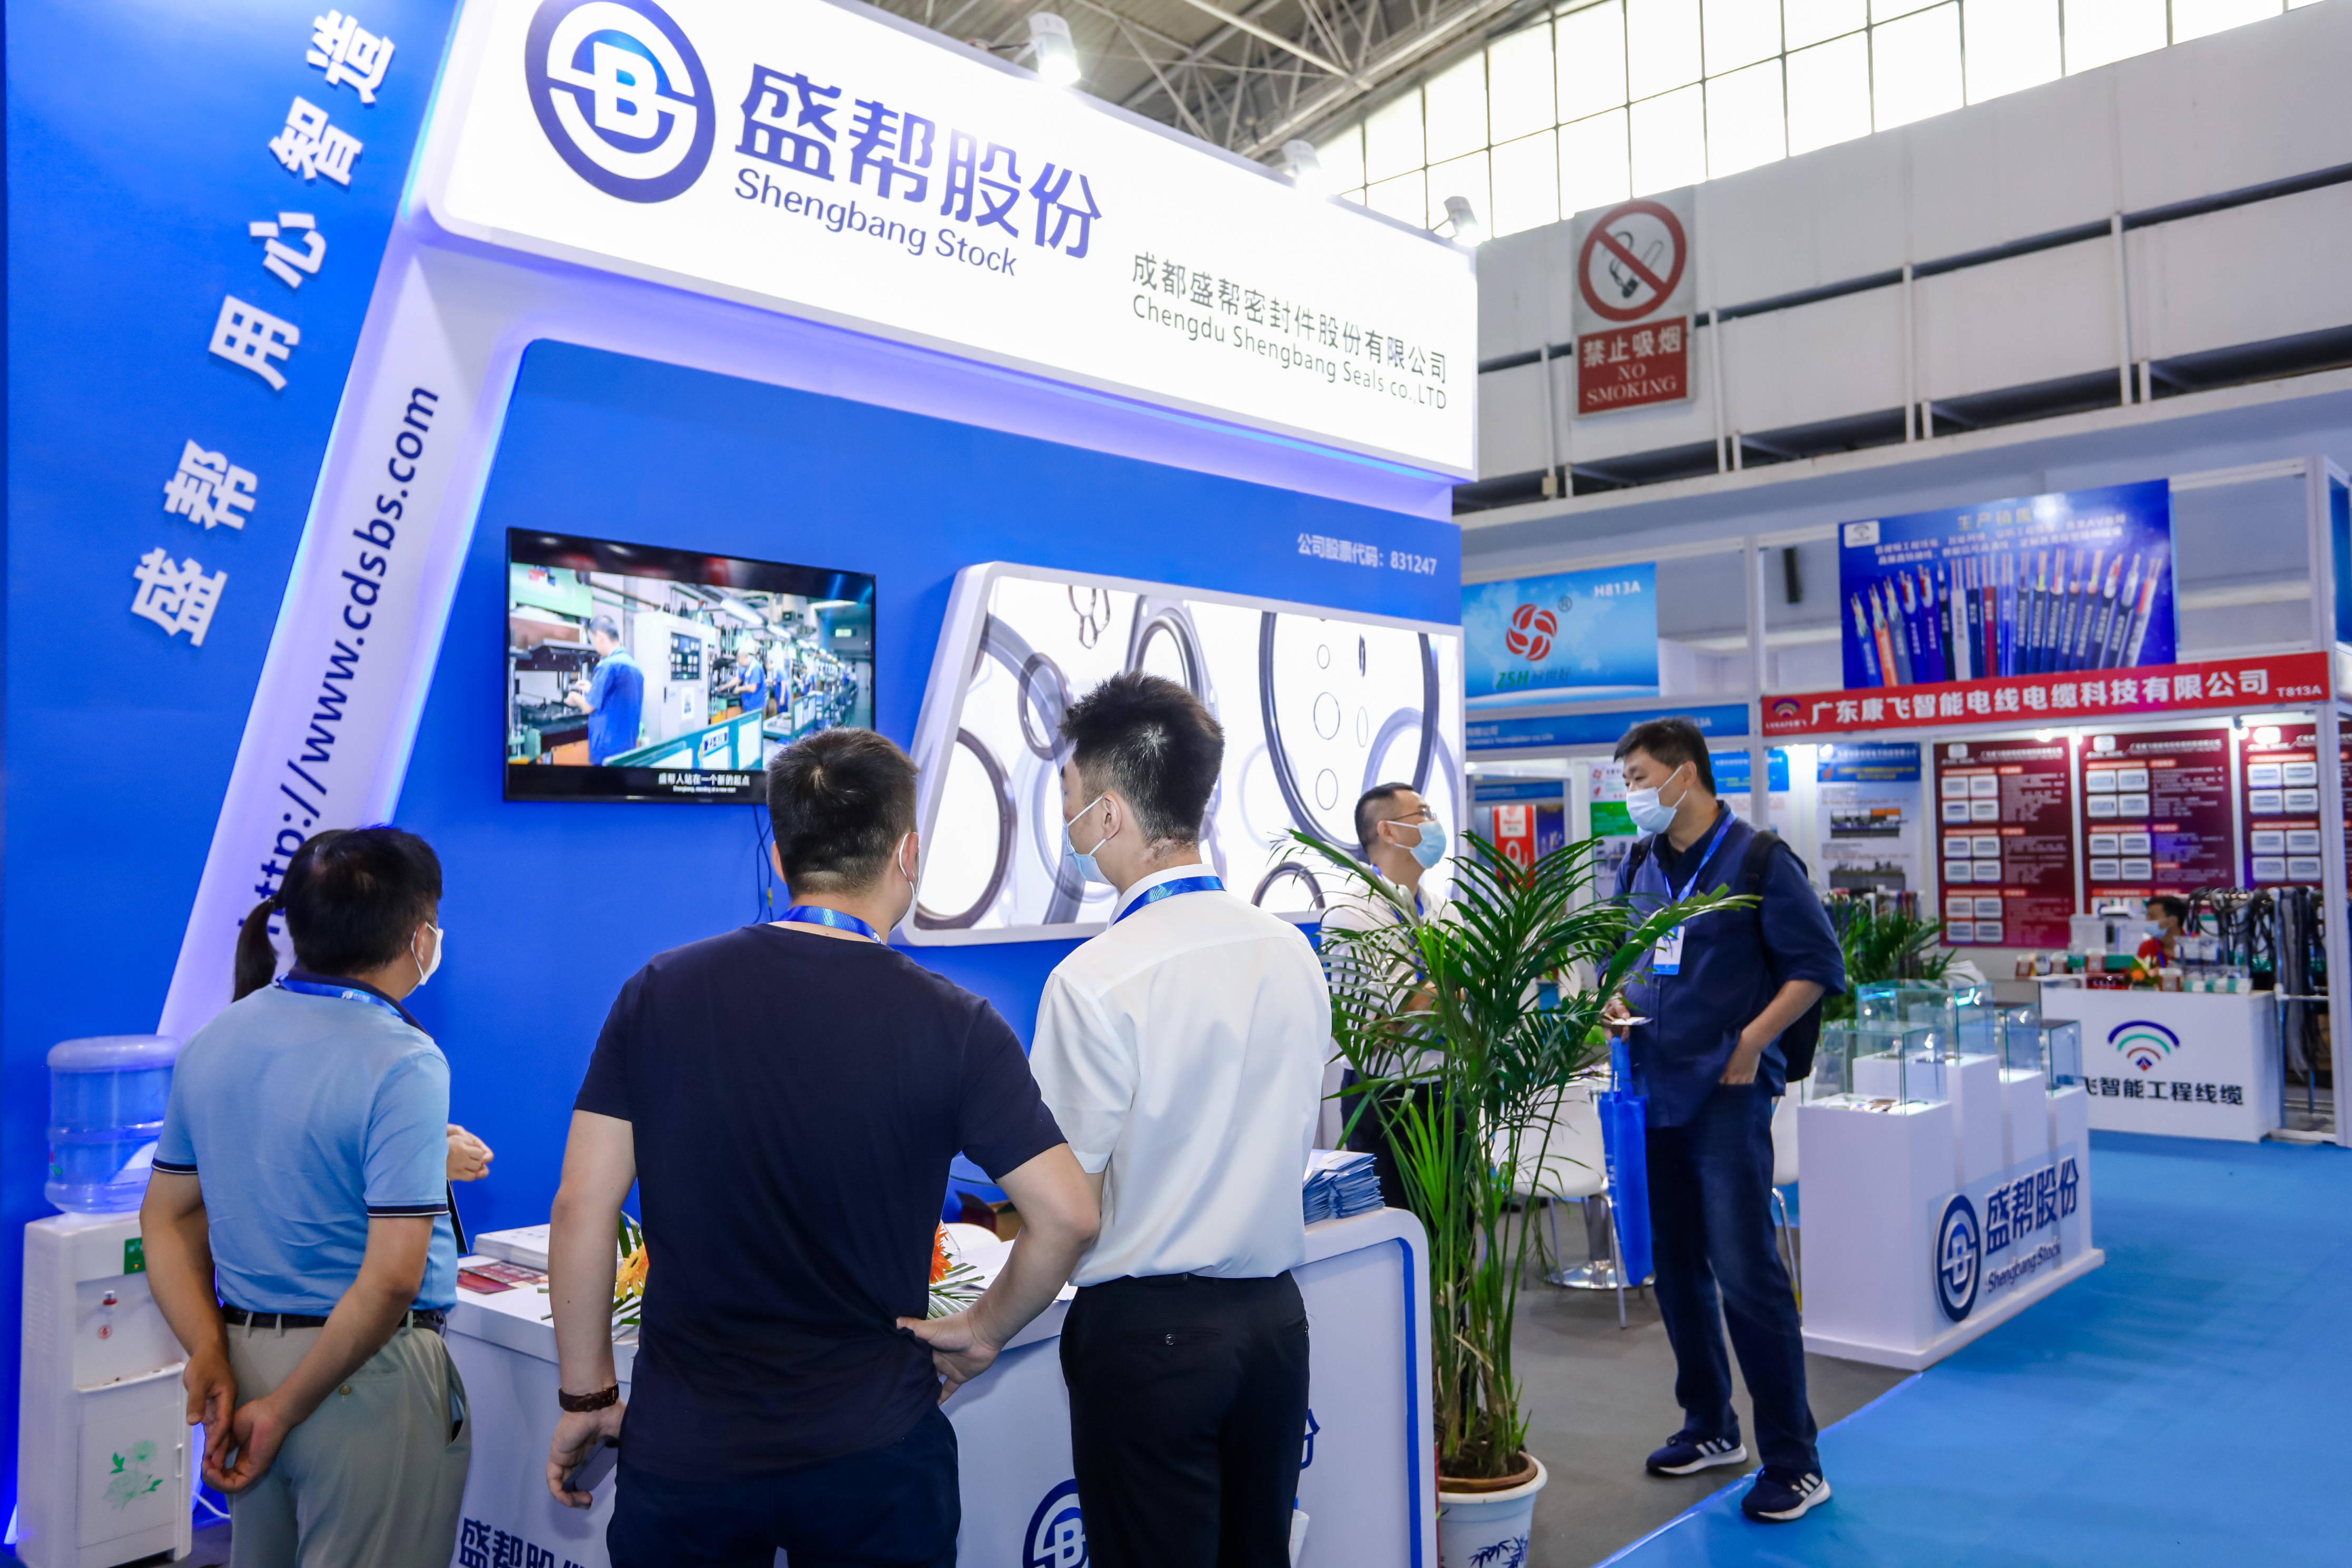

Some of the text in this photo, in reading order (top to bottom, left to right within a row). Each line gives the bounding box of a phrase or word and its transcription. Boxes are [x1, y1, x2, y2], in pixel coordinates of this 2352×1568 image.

[734, 62, 1102, 259] 盛帮股份
[734, 168, 1017, 277] Shengbang Stock
[131, 9, 396, 648] 盛帮 用心智造
[1132, 251, 1446, 384] 成都盛帮密封件股份有限公司
[1132, 295, 1225, 342] Chengdu
[1233, 326, 1337, 384] Shengbang
[1343, 361, 1385, 393] Seals
[1583, 325, 1682, 368] 禁止吸烟
[1586, 375, 1677, 406] SMOKING
[1617, 363, 1647, 381] NO
[1390, 550, 1438, 576] 831247
[1594, 580, 1641, 597] H813A
[1810, 669, 2269, 726] 广东康飞智能电线电缆科技有限公司
[1985, 1157, 2080, 1256] 盛帮股份
